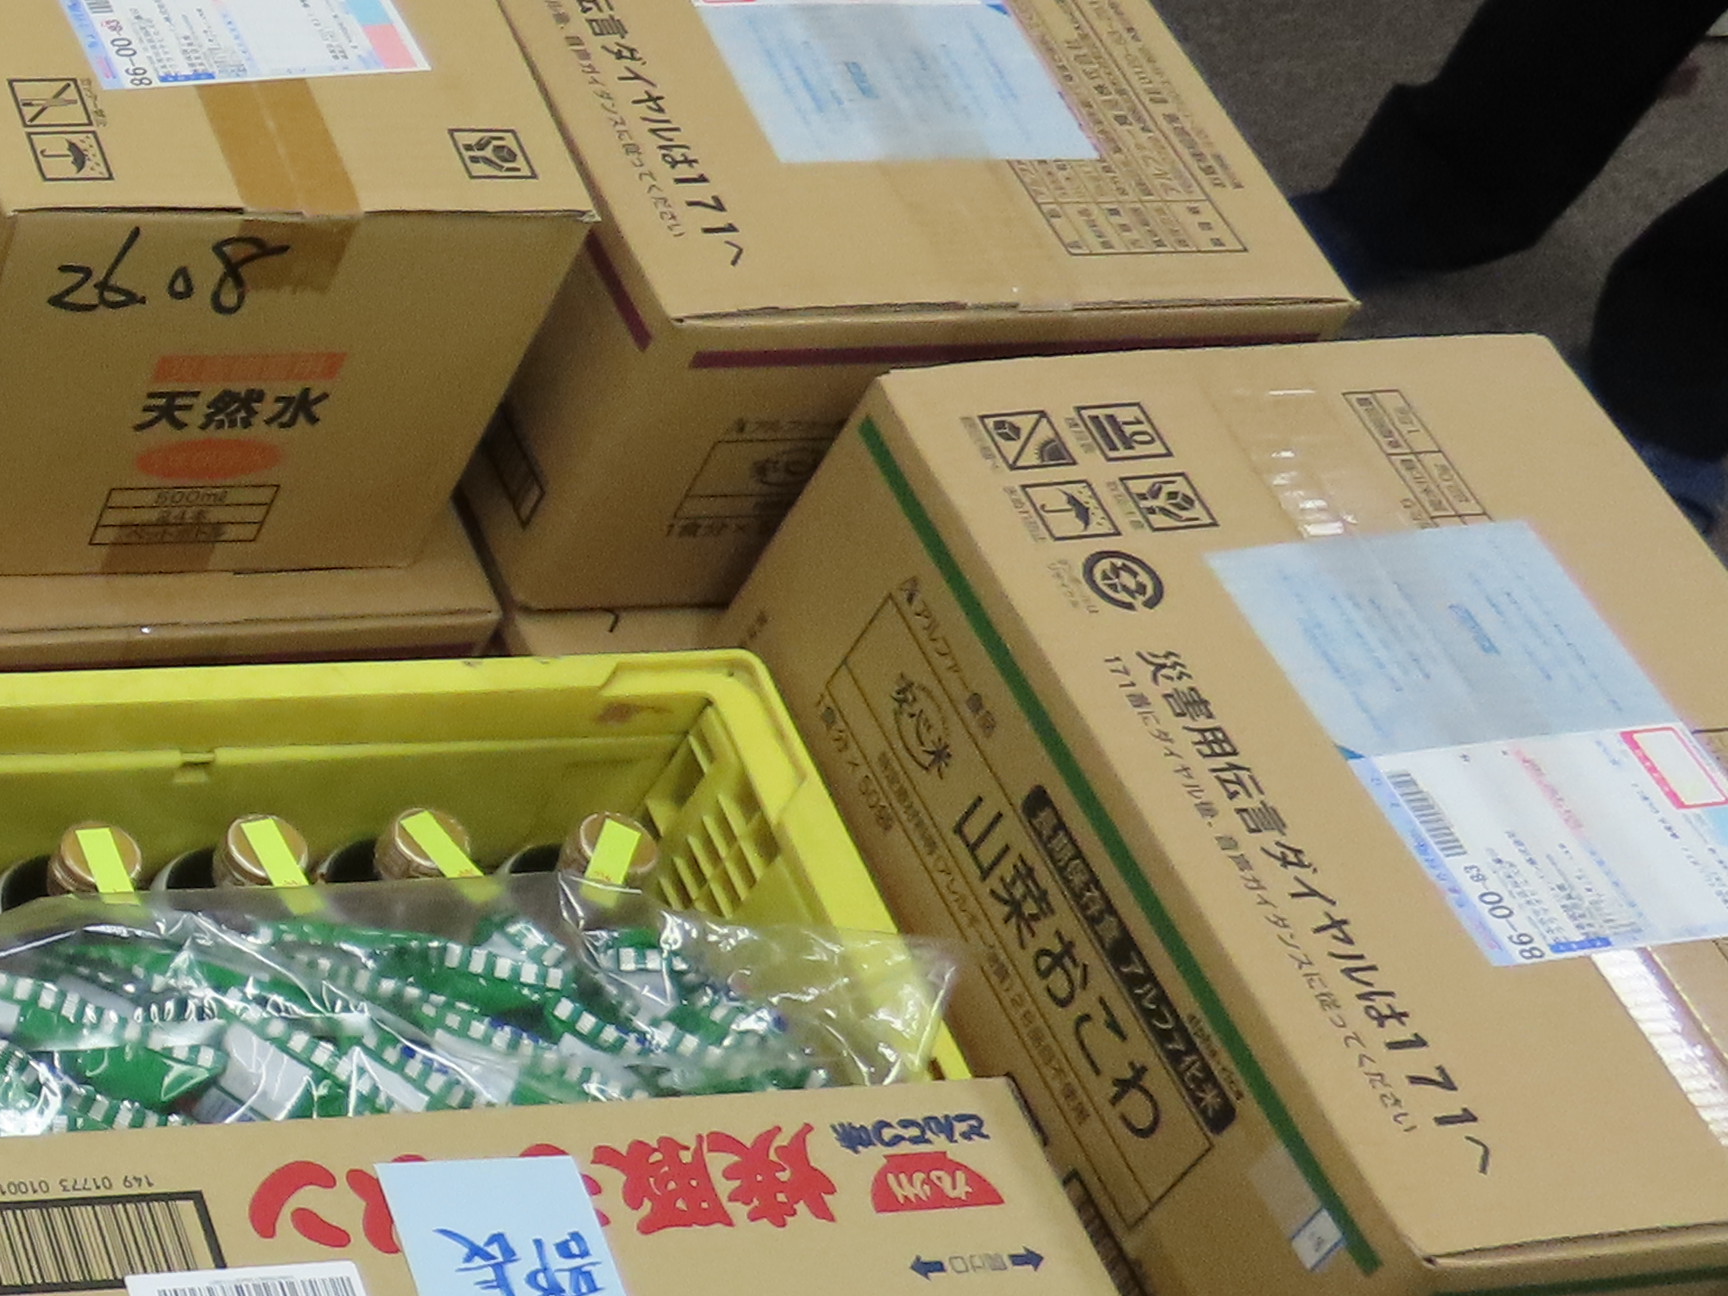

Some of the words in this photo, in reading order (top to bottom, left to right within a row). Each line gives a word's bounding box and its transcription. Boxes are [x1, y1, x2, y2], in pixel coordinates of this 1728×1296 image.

[46, 226, 291, 316] 26.08
[131, 387, 331, 433] 天然水
[1120, 415, 1156, 446] 10
[1137, 649, 1495, 1175] 災害用伝言ダイヤルは171へ
[951, 792, 1165, 1142] 山菜おこわ
[830, 1112, 992, 1154] とんこつ味
[0, 1181, 50, 1197] 01001
[60, 1177, 116, 1192] 01773
[131, 1174, 155, 1189] 149
[887, 1166, 976, 1204] 九州
